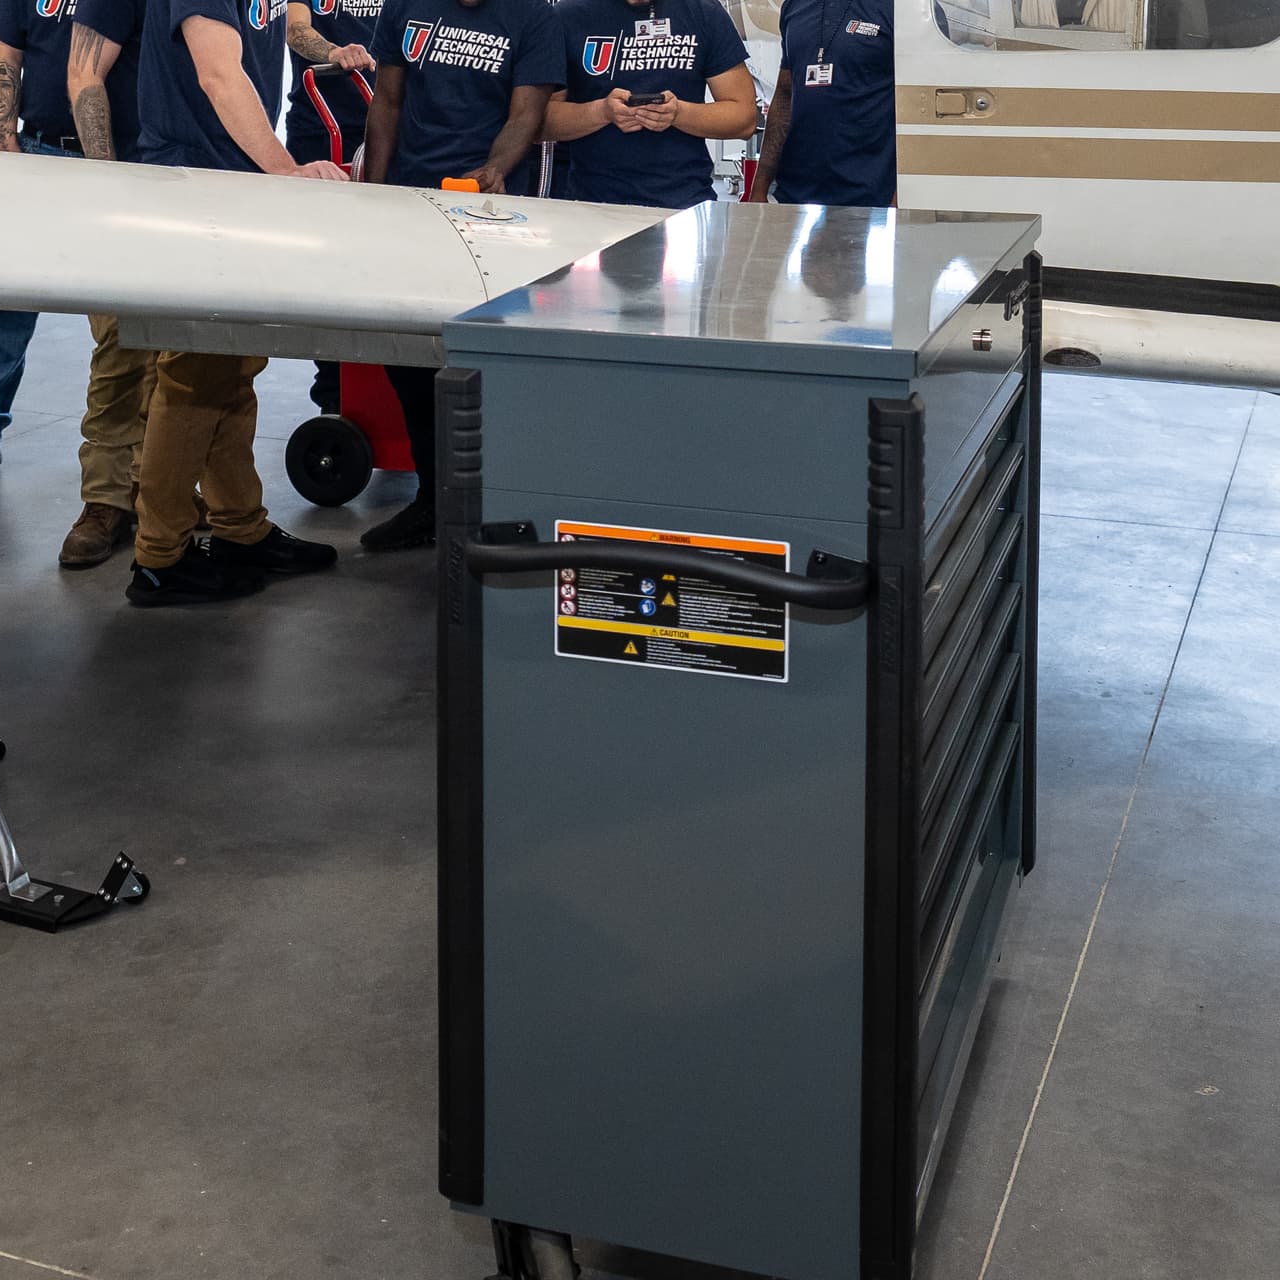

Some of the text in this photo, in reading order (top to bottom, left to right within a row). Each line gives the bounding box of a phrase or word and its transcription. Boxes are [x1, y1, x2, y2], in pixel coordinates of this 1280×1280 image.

[438, 25, 511, 50] UNIVERSAL
[434, 37, 505, 61] TECHNICAL
[621, 46, 697, 59] TECHNICAL
[428, 50, 502, 73] INSTITUTE
[620, 58, 695, 71] INSTITUTE
[659, 628, 690, 639] CAUTION
